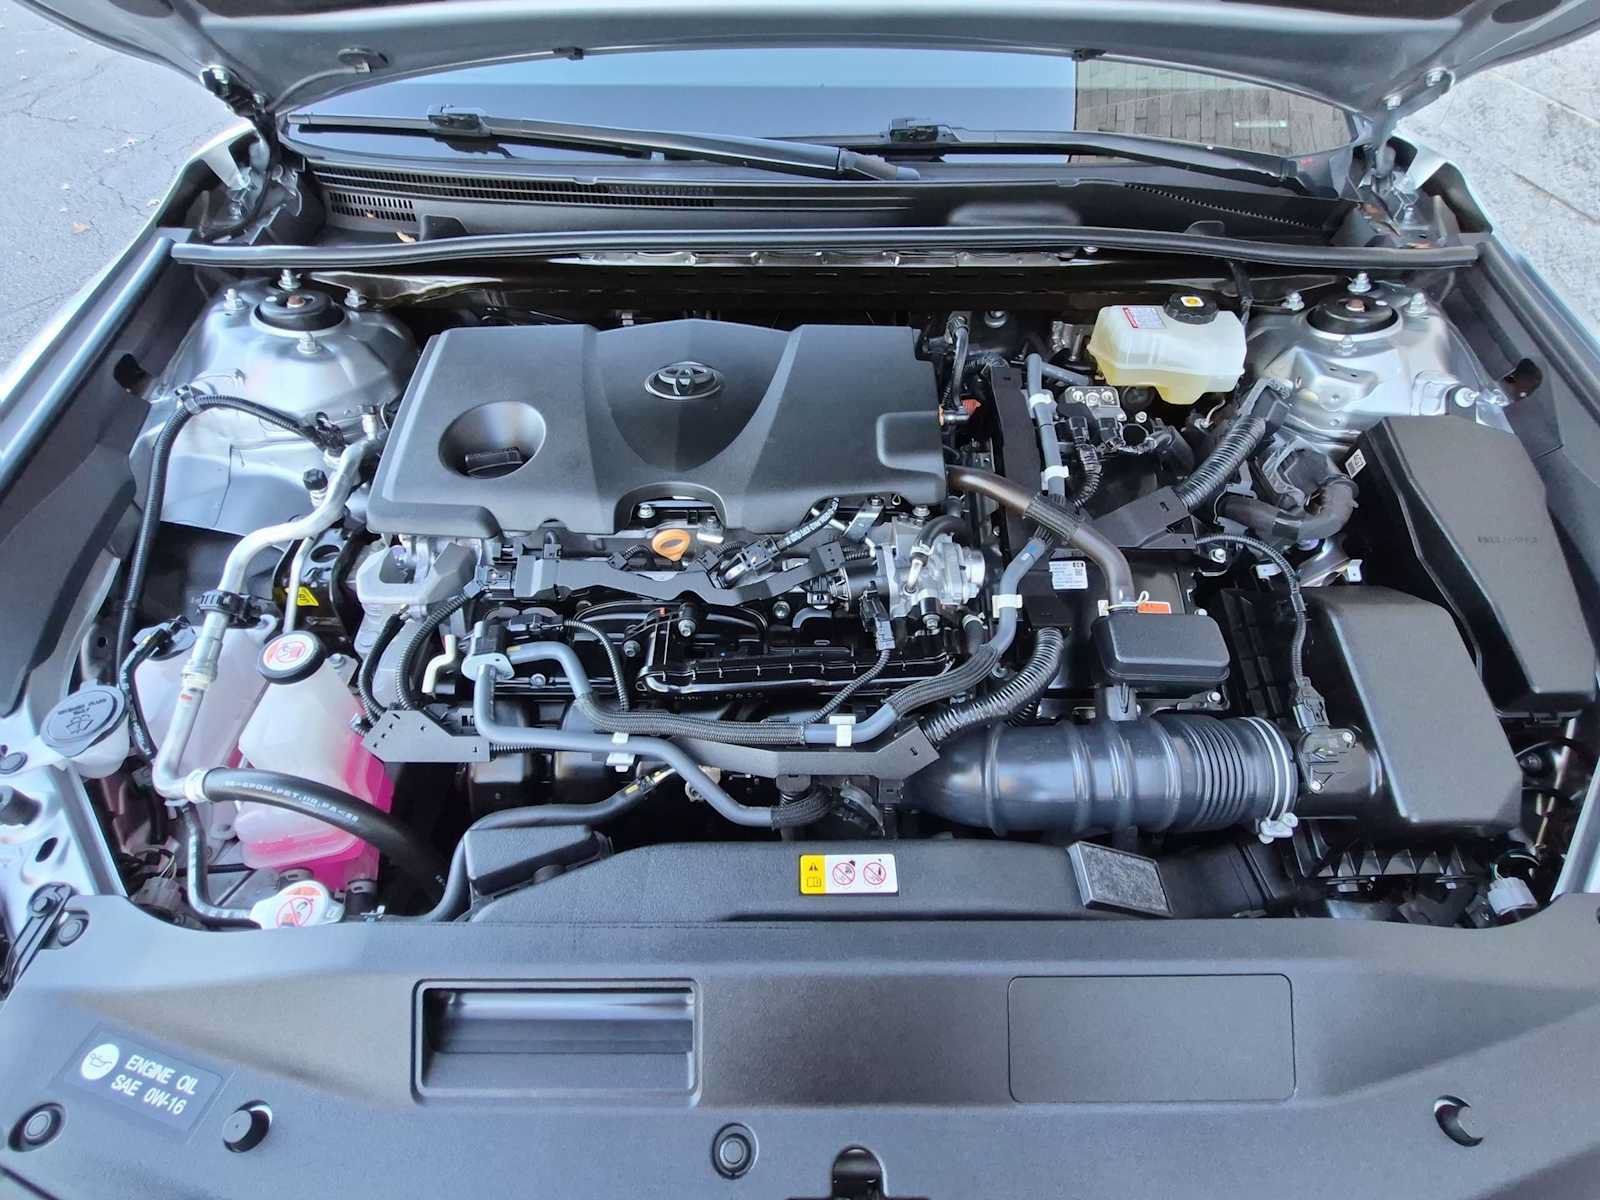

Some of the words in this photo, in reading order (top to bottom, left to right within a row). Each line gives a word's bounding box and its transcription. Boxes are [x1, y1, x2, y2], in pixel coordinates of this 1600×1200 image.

[111, 1074, 143, 1097] SAE
[143, 1088, 188, 1115] 0W-16
[125, 1054, 176, 1084] ENGINE
[176, 1075, 199, 1095] OIL
